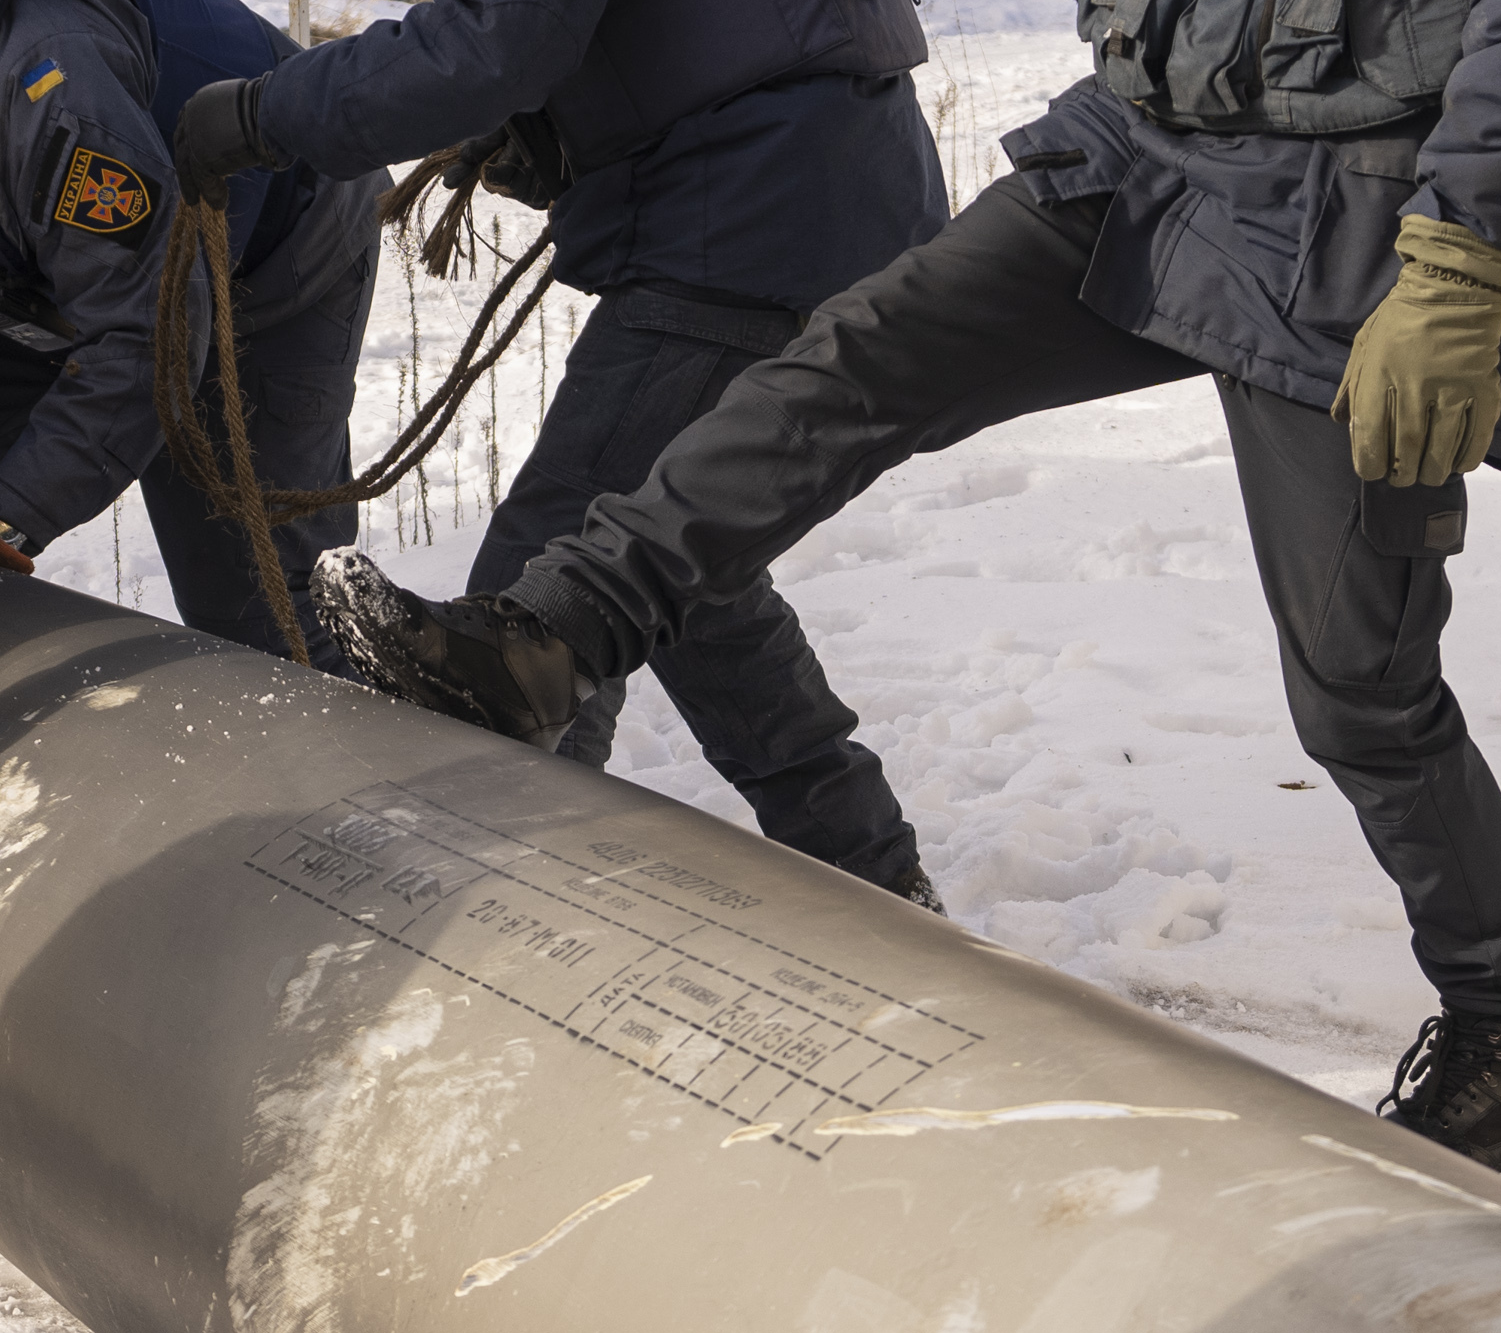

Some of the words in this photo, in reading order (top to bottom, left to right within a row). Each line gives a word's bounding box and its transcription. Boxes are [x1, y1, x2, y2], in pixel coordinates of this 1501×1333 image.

[60, 154, 88, 218] УКРАЇНА
[128, 189, 143, 221] ДСНС
[600, 972, 646, 1007] ДАТА
